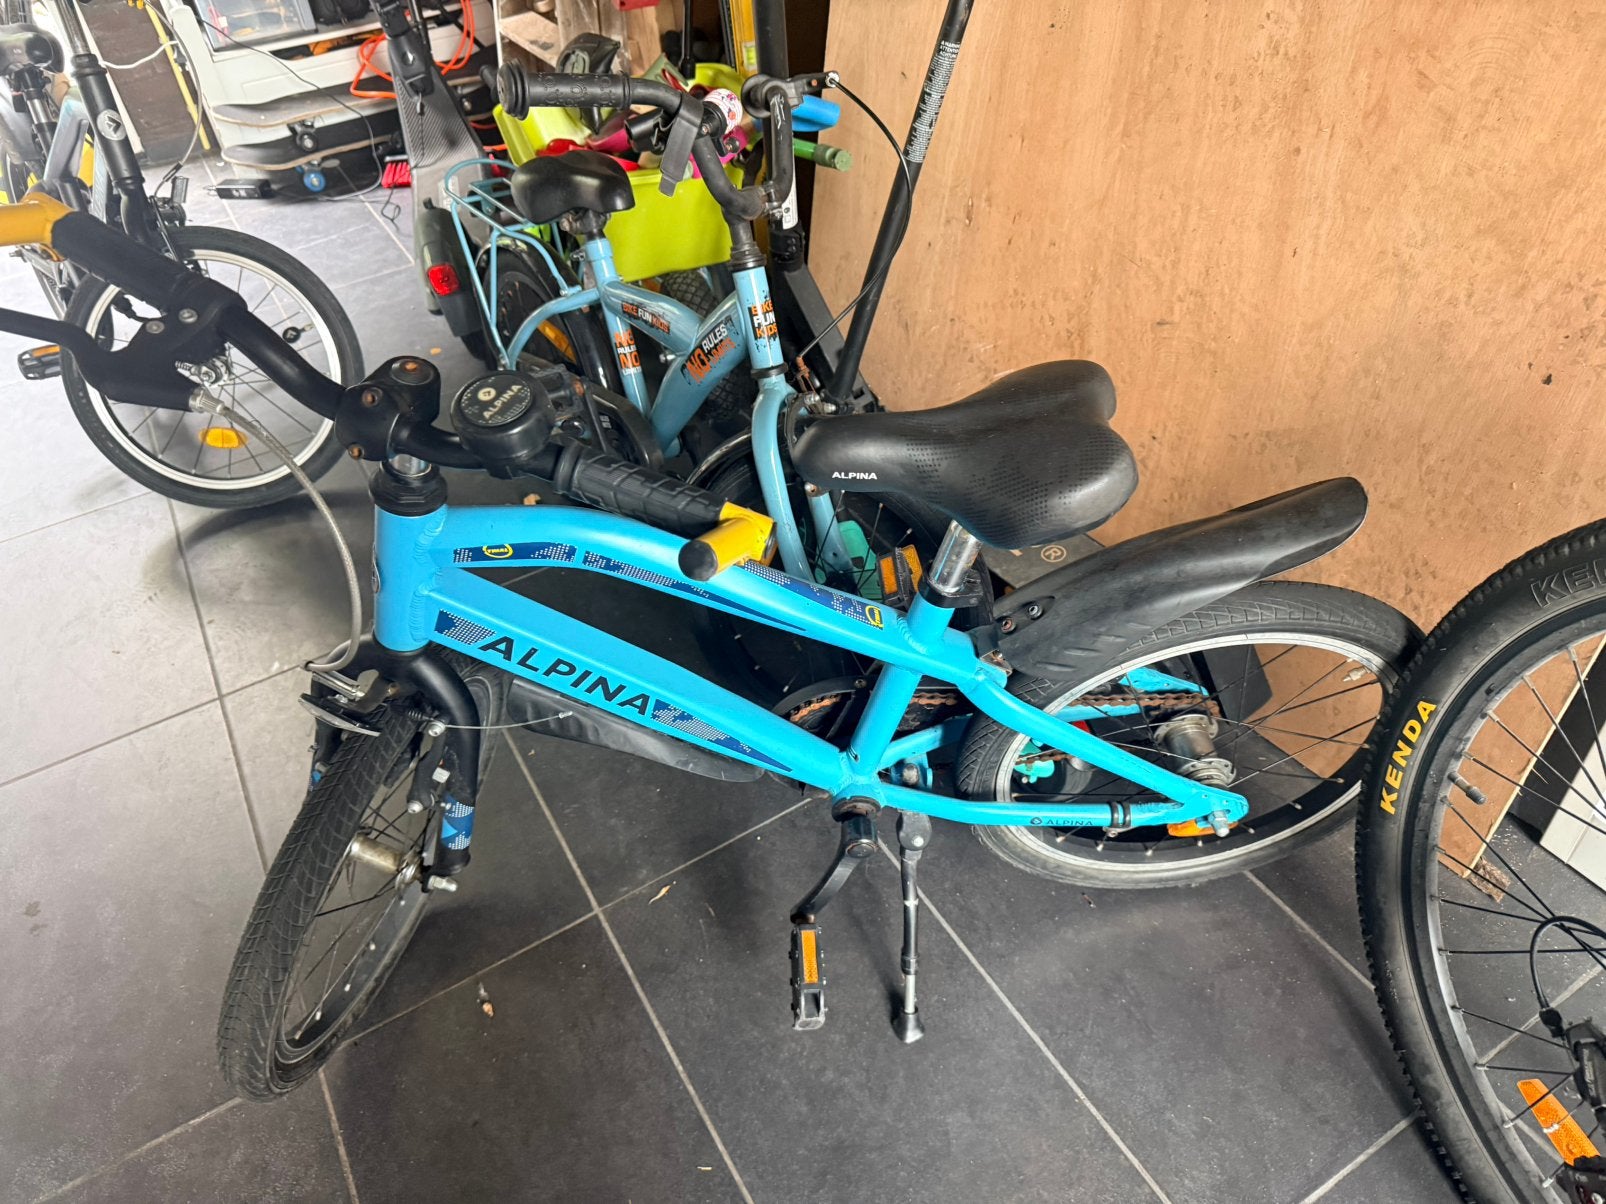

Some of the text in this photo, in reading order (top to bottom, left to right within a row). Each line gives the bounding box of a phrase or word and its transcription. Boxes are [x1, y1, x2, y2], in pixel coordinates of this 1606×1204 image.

[622, 302, 671, 333] BIKE FUN KIDS
[756, 323, 778, 339] KIDS
[702, 323, 728, 353] RULES
[619, 351, 641, 369] NO
[685, 348, 712, 384] NO
[483, 385, 522, 419] ALPINA
[831, 471, 878, 480] ALPINA
[478, 635, 651, 716] ALPINA
[1380, 700, 1437, 815] KENDA
[1046, 818, 1093, 827] ALPINA
